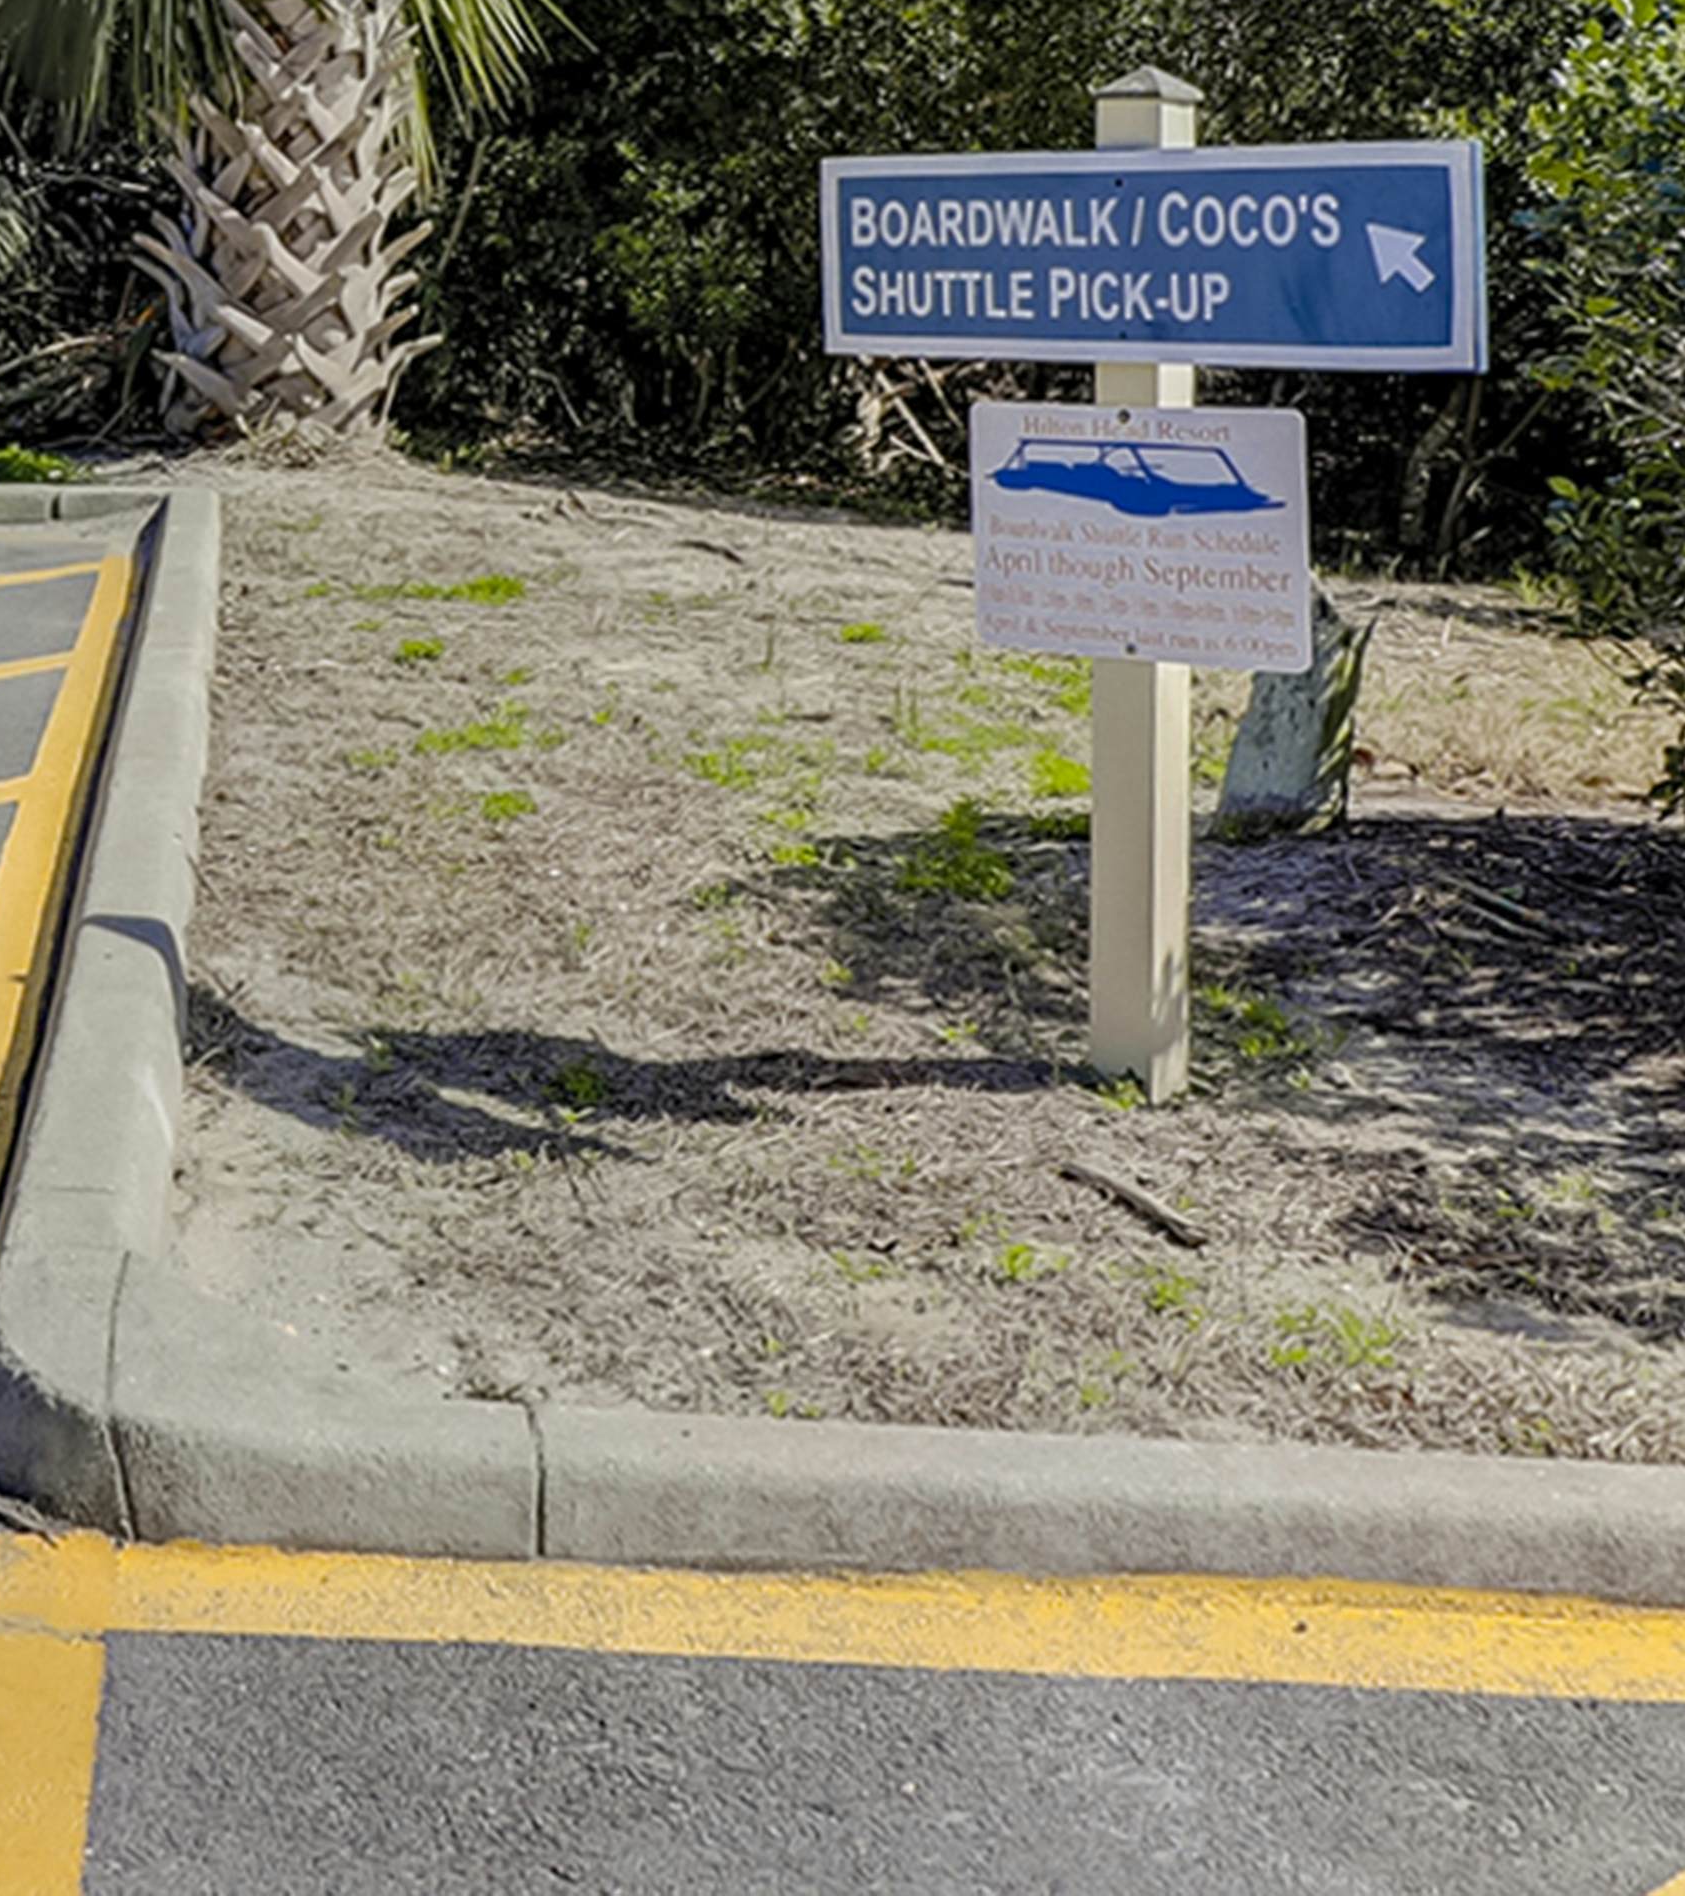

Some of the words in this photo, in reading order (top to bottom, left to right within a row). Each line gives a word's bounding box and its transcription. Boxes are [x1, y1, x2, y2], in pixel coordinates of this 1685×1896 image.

[850, 196, 1121, 248] BOARDWALK
[1130, 196, 1146, 247] /
[1157, 191, 1341, 248] COCO'S
[851, 264, 1033, 318] SHUTTLE
[1049, 267, 1230, 322] PICK-UP
[1157, 420, 1230, 441] Resort
[983, 545, 1041, 578] April
[1142, 555, 1293, 594] September
